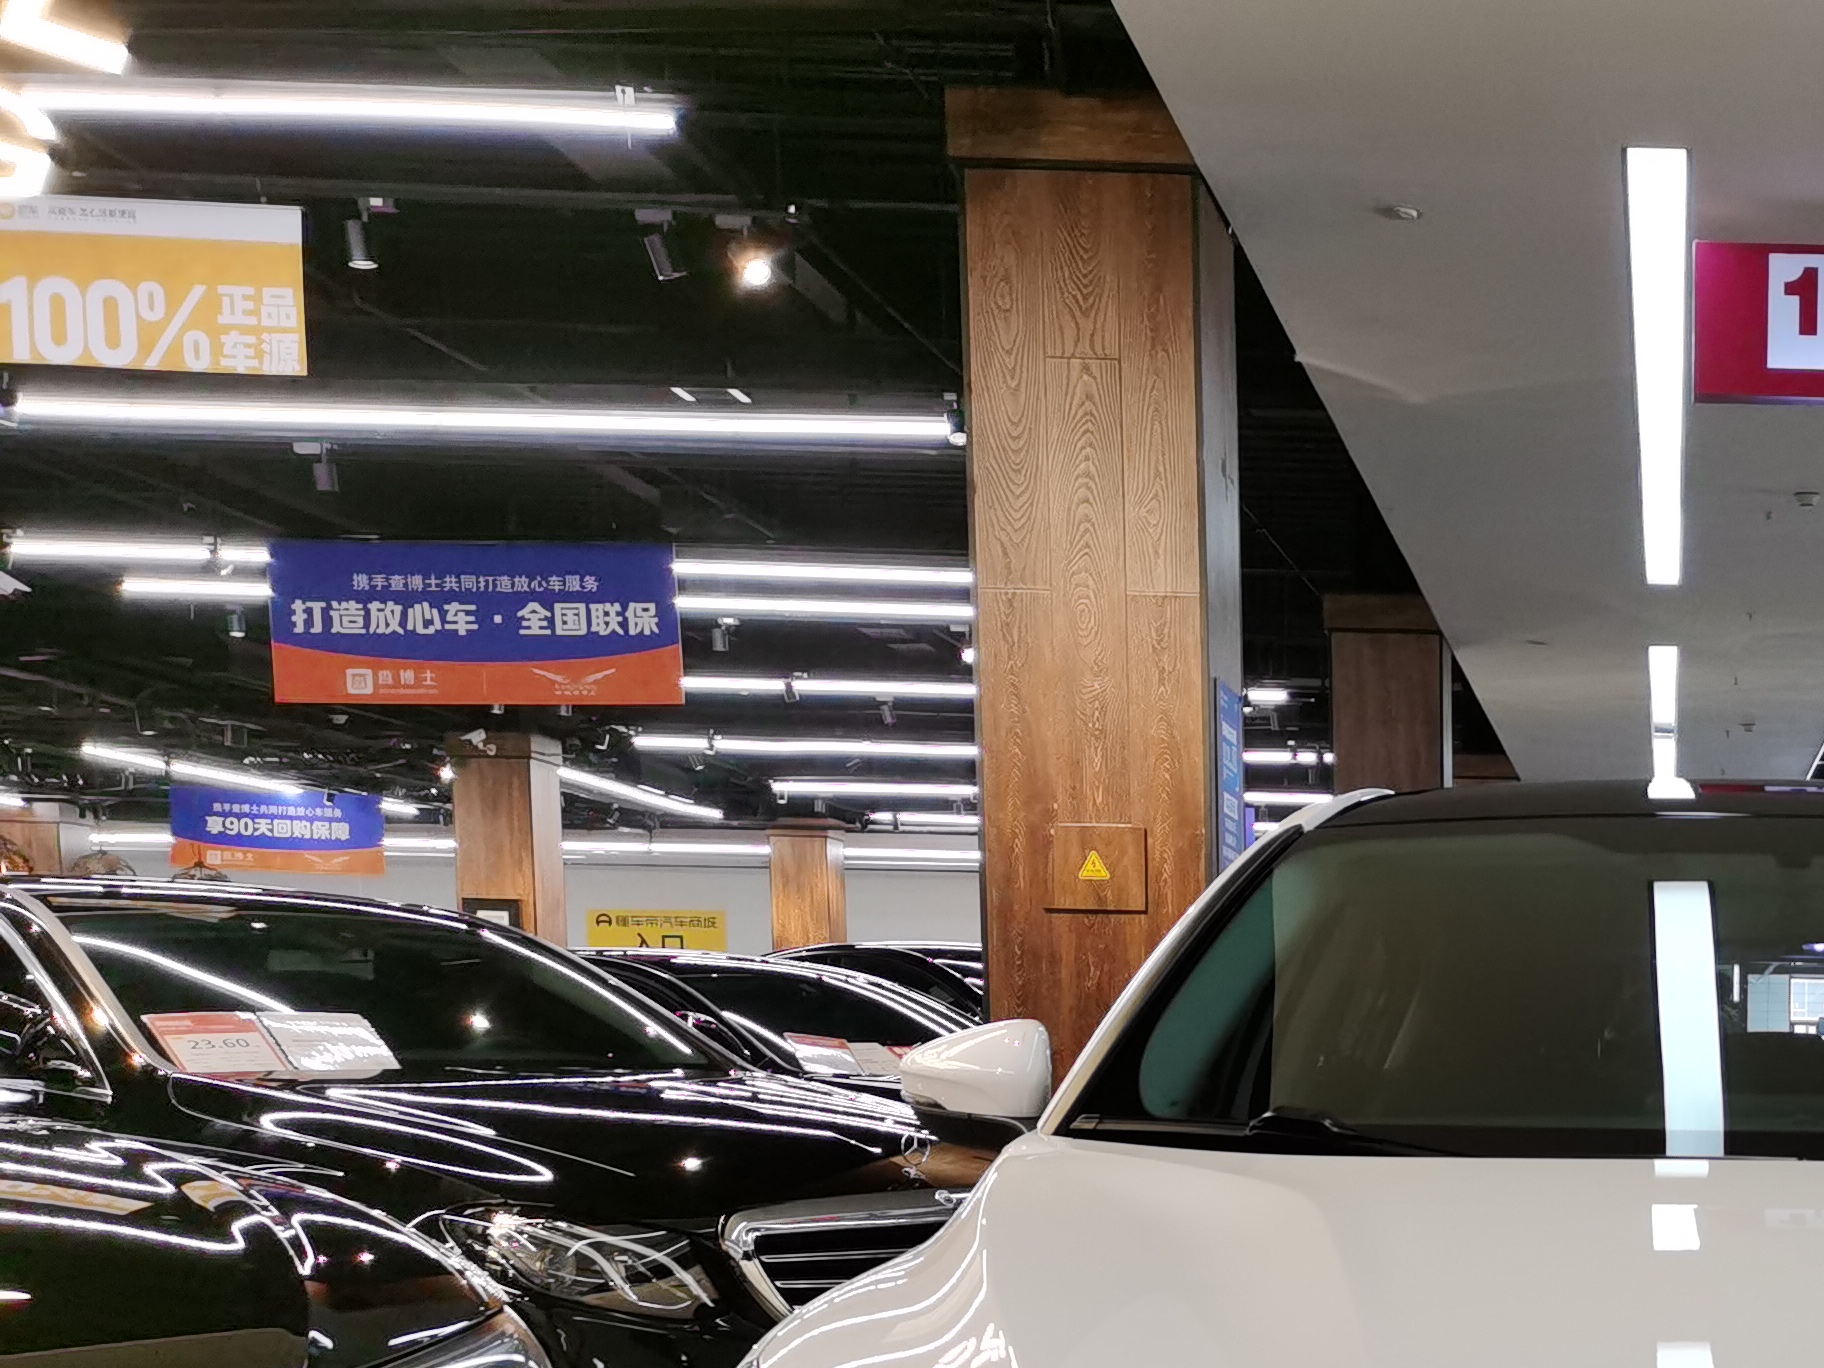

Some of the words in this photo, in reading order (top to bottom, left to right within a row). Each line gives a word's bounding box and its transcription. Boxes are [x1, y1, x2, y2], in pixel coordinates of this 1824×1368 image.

[0, 275, 211, 370] 100%
[216, 284, 299, 328] 正品
[219, 330, 301, 372] 车源
[205, 815, 351, 841] 享90天回购保障
[188, 1038, 251, 1050] 23.60
